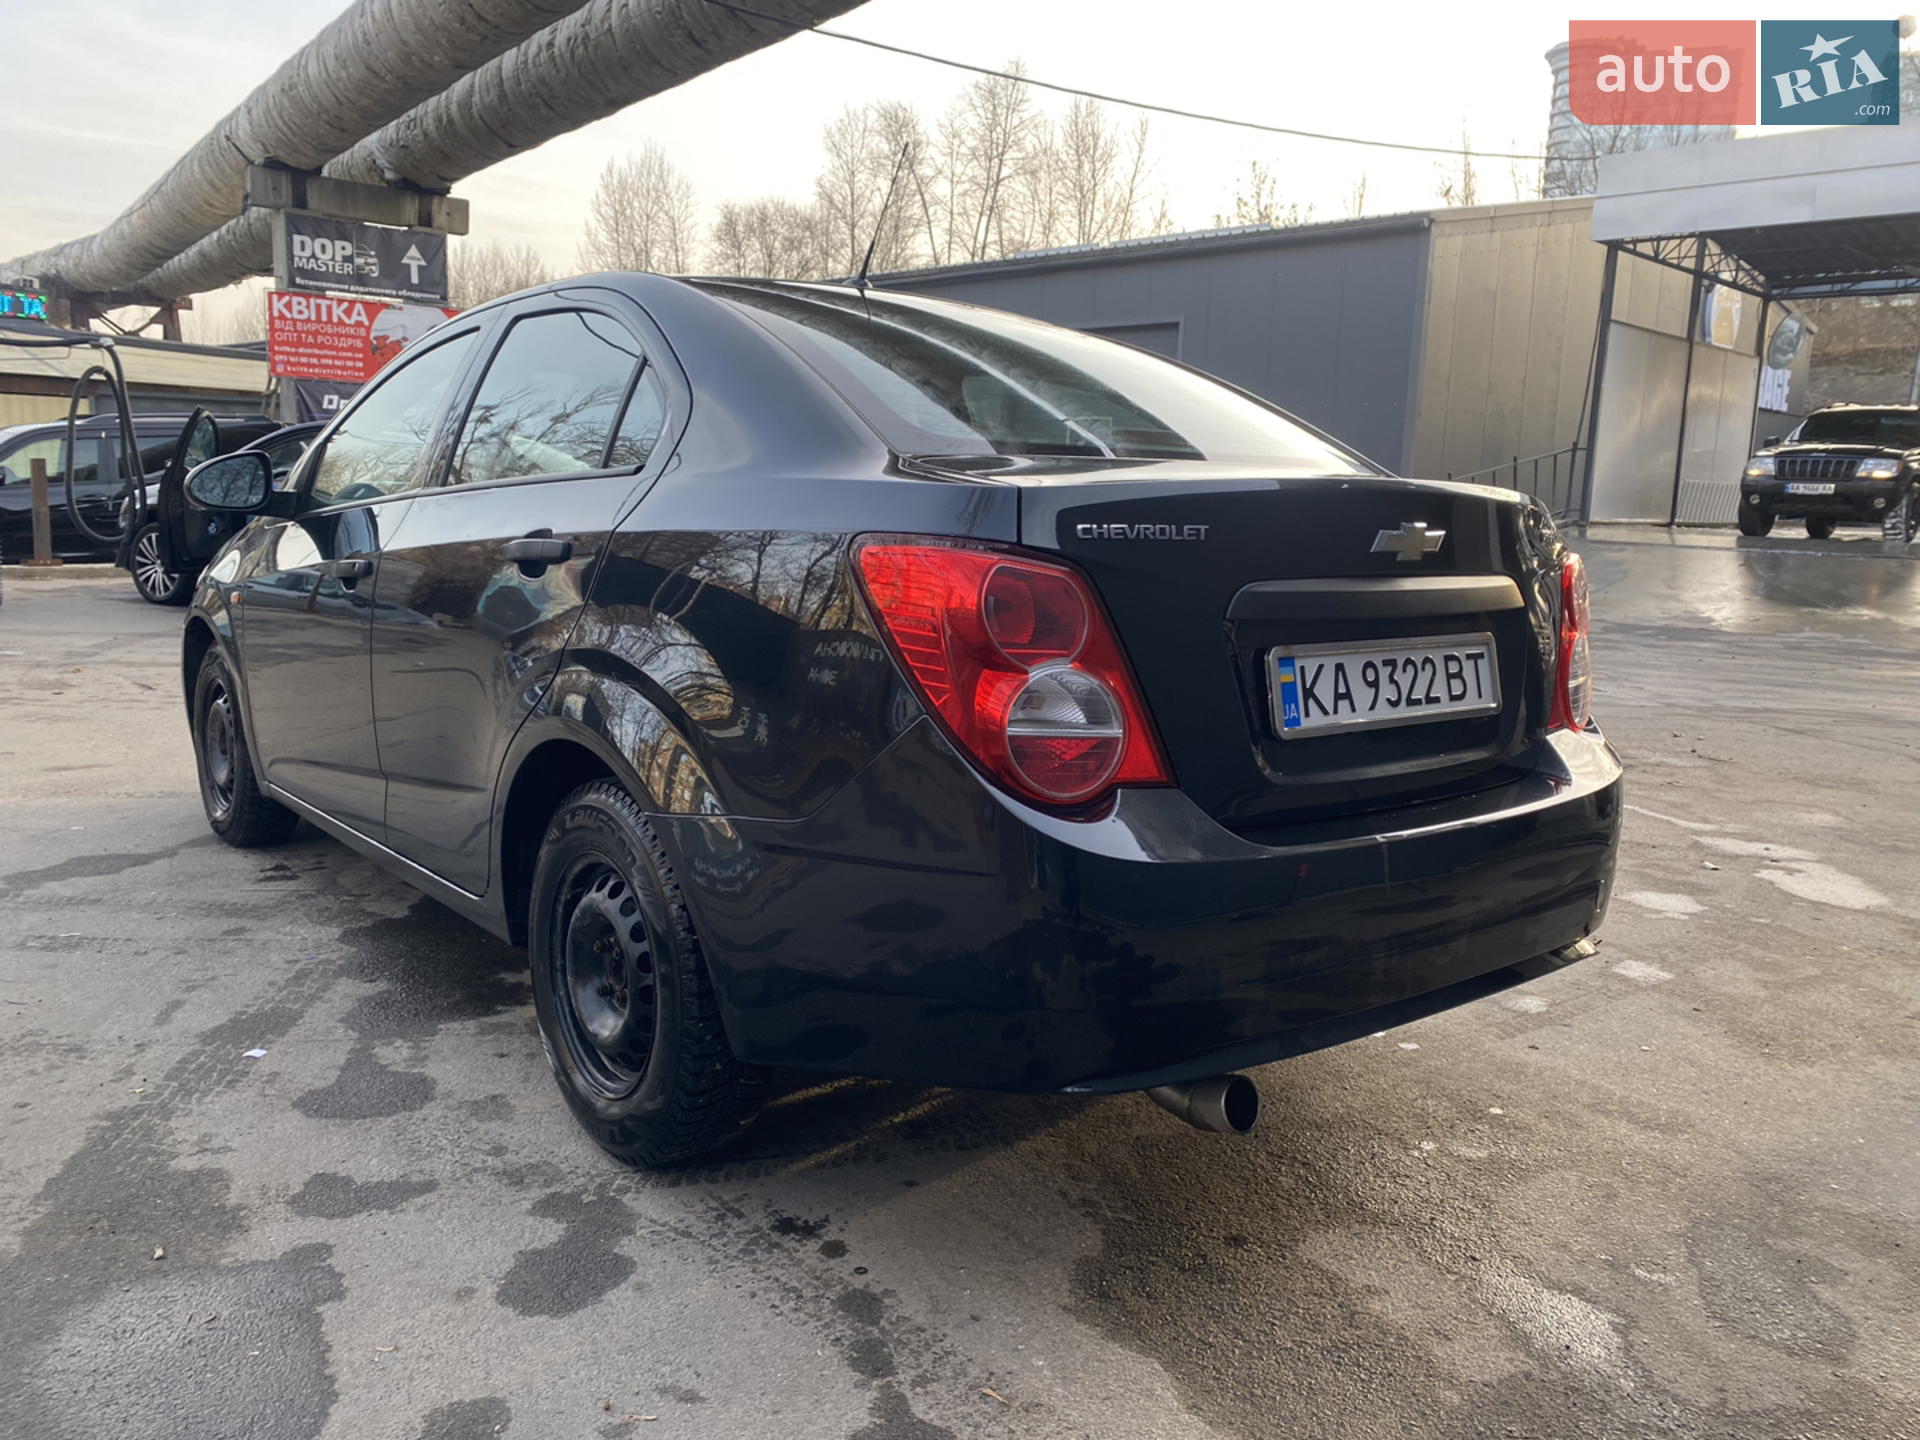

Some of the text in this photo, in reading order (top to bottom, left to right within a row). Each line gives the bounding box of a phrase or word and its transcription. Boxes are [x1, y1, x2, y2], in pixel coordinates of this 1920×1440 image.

[292, 233, 353, 262] DOP
[293, 256, 353, 276] MASTER
[272, 294, 369, 327] КВІТКА
[274, 319, 366, 337] ВІД ВИРОБНИКІВ
[274, 331, 364, 349] ОПТ ТА РОЗДРІБ
[1076, 523, 1210, 541] CHEVROLET
